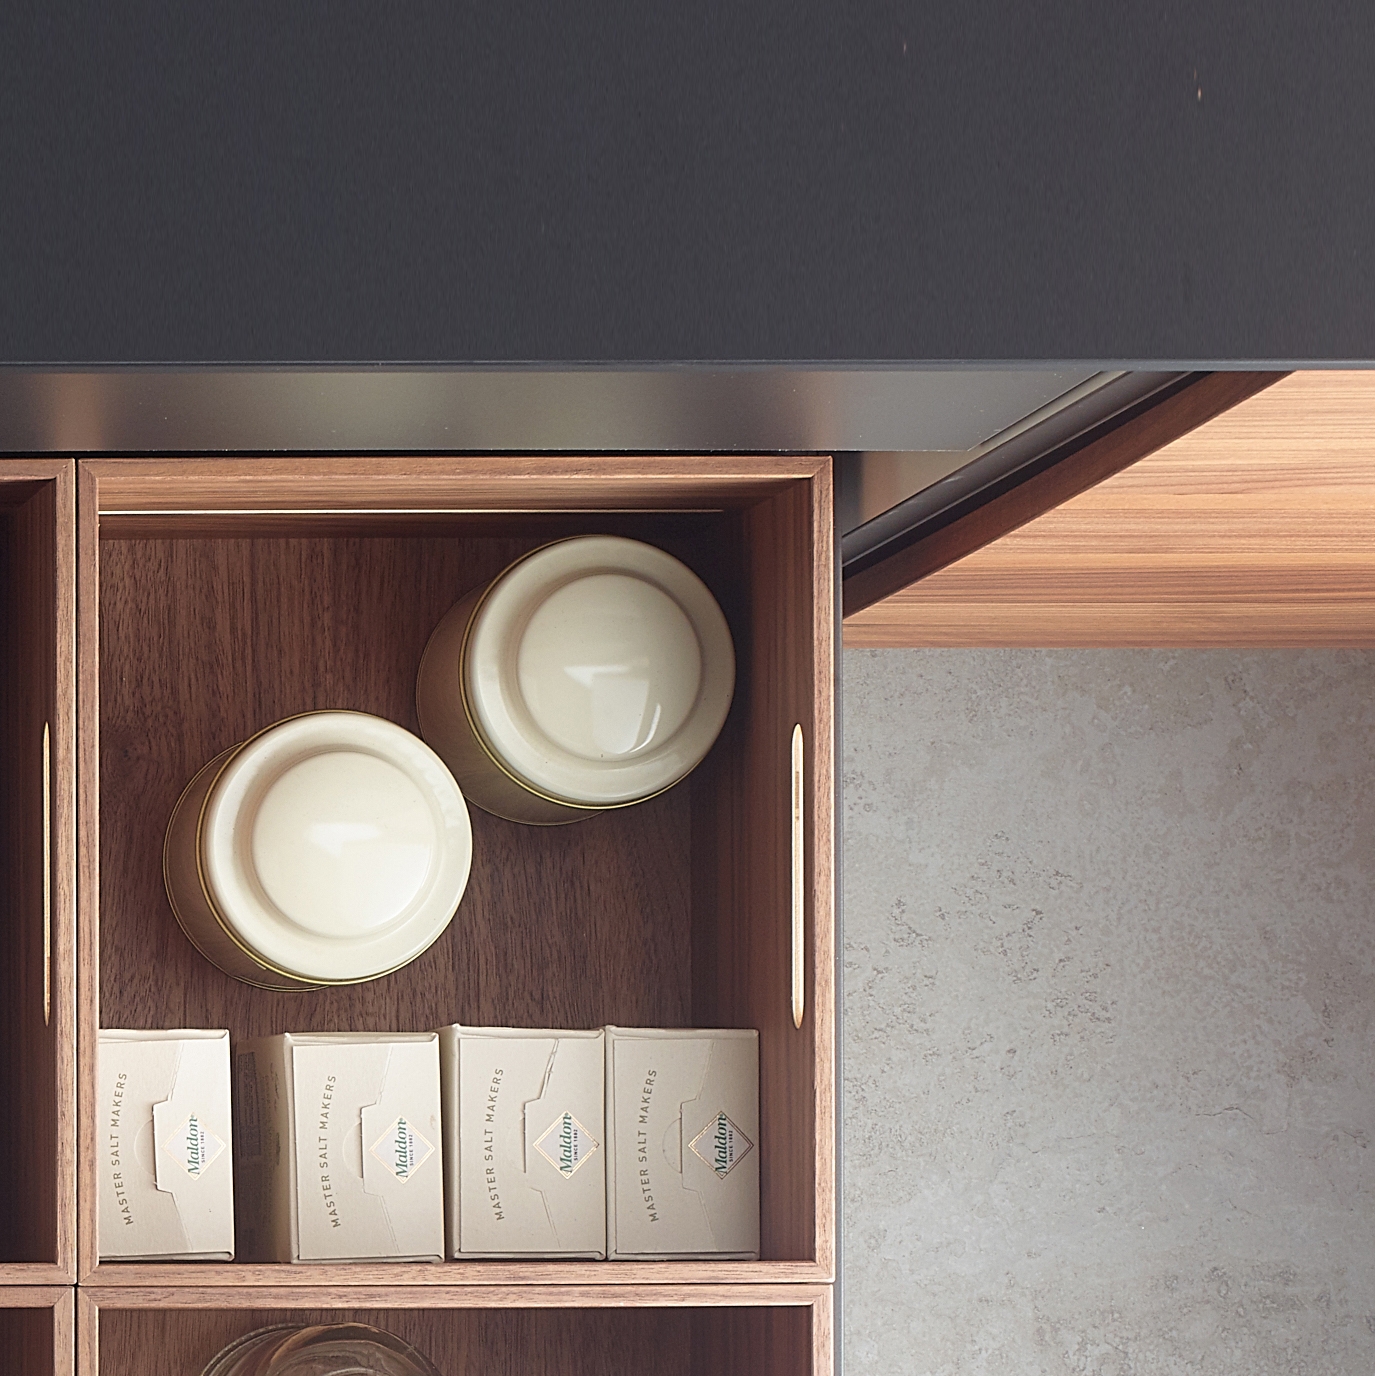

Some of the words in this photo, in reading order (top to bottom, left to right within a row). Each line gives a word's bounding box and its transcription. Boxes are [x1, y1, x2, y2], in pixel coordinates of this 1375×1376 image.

[110, 1072, 128, 1127] MAKERS
[319, 1075, 336, 1129] MAKERS
[485, 1067, 504, 1124] MAKERS
[640, 1069, 658, 1126] MAKERS
[110, 1129, 121, 1166] SALT
[318, 1132, 329, 1168] SALT
[484, 1128, 494, 1163] SALT
[638, 1129, 648, 1164] SALT
[111, 1172, 134, 1226] MASTER
[320, 1174, 342, 1228] MASTER
[485, 1168, 505, 1221] MASTER
[640, 1169, 659, 1222] MASTER
